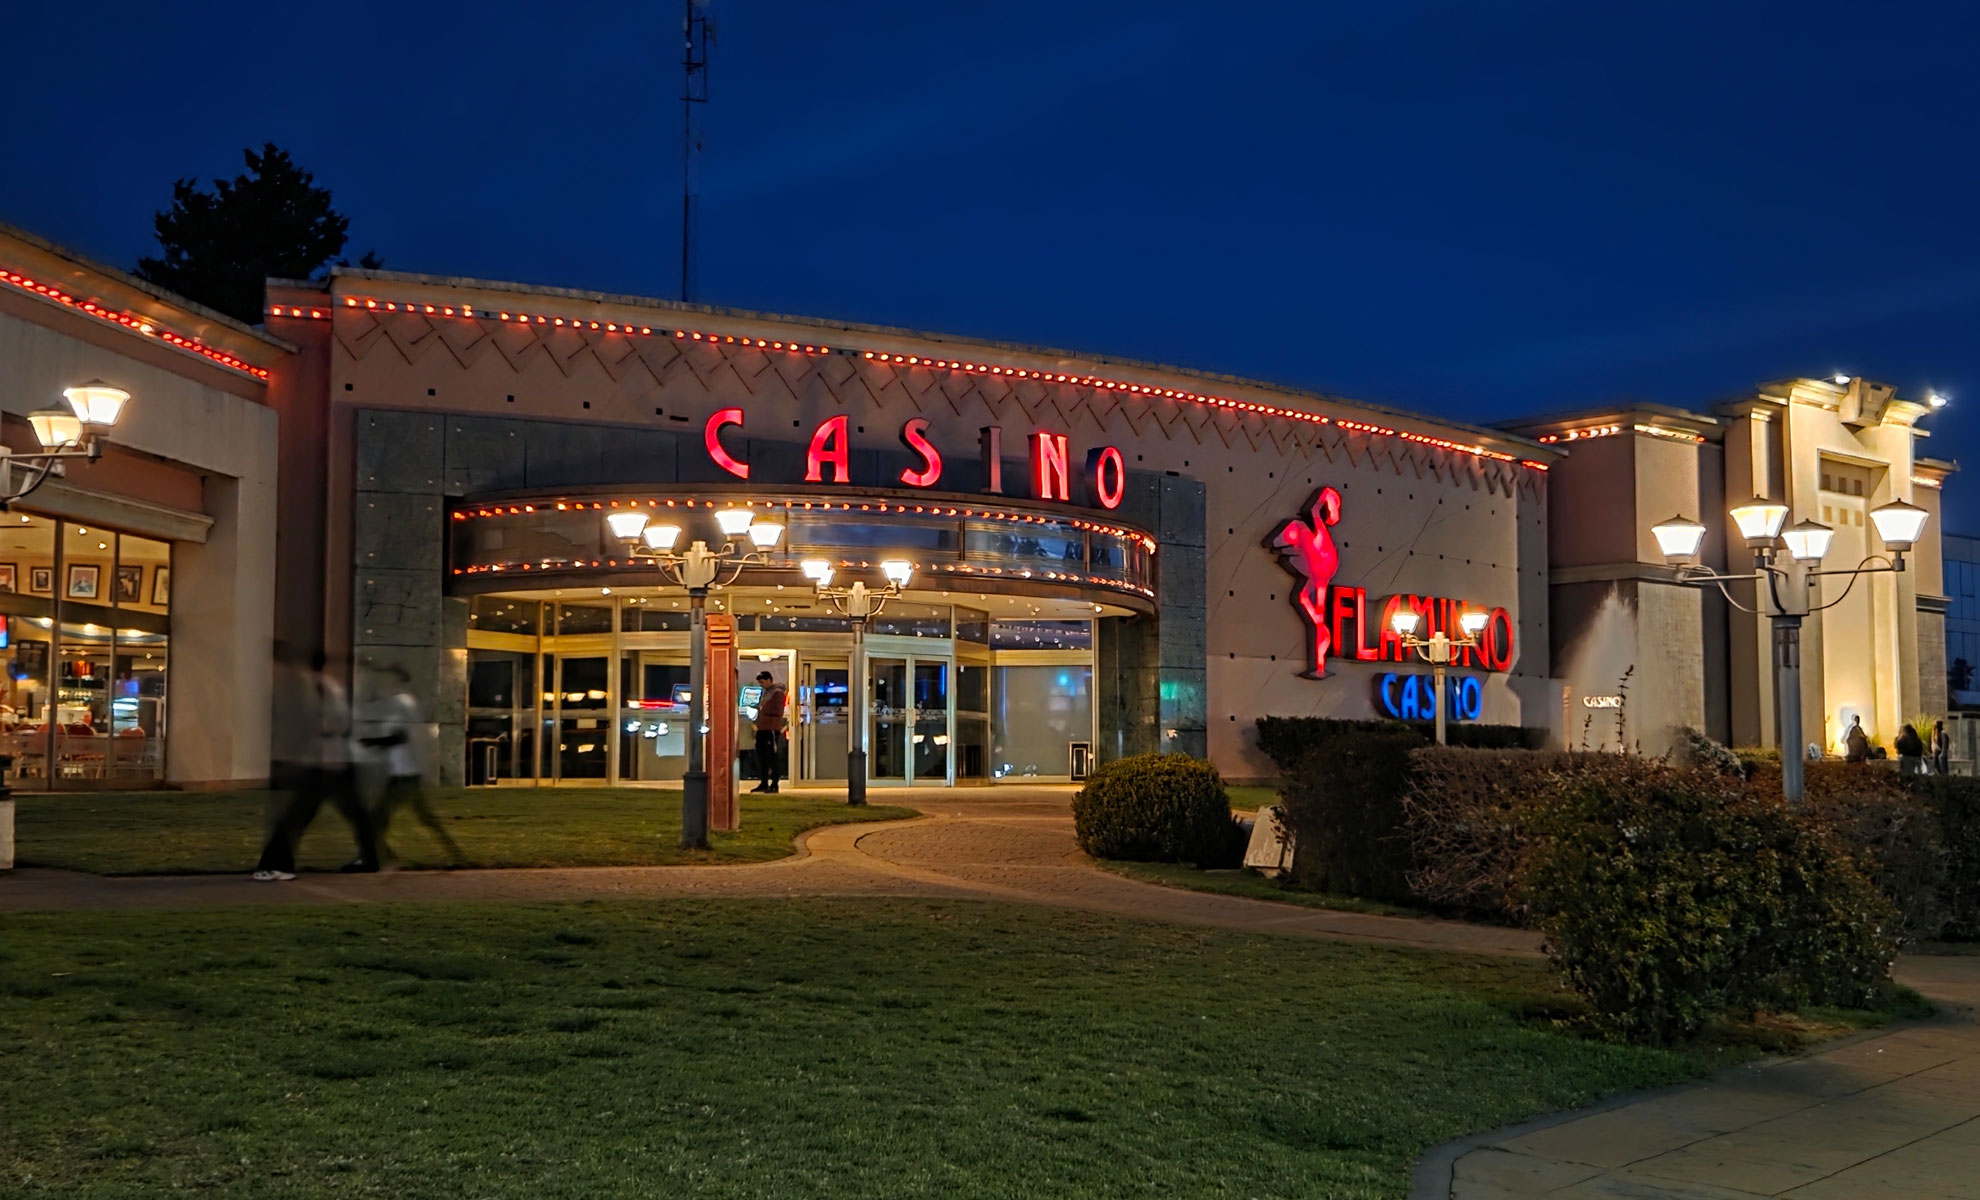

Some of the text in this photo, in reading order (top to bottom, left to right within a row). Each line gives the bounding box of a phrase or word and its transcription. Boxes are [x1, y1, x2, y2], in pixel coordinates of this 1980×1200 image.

[703, 407, 1126, 510] CASINO
[1381, 672, 1482, 721] CASNO
[1583, 695, 1621, 708] CASINO
